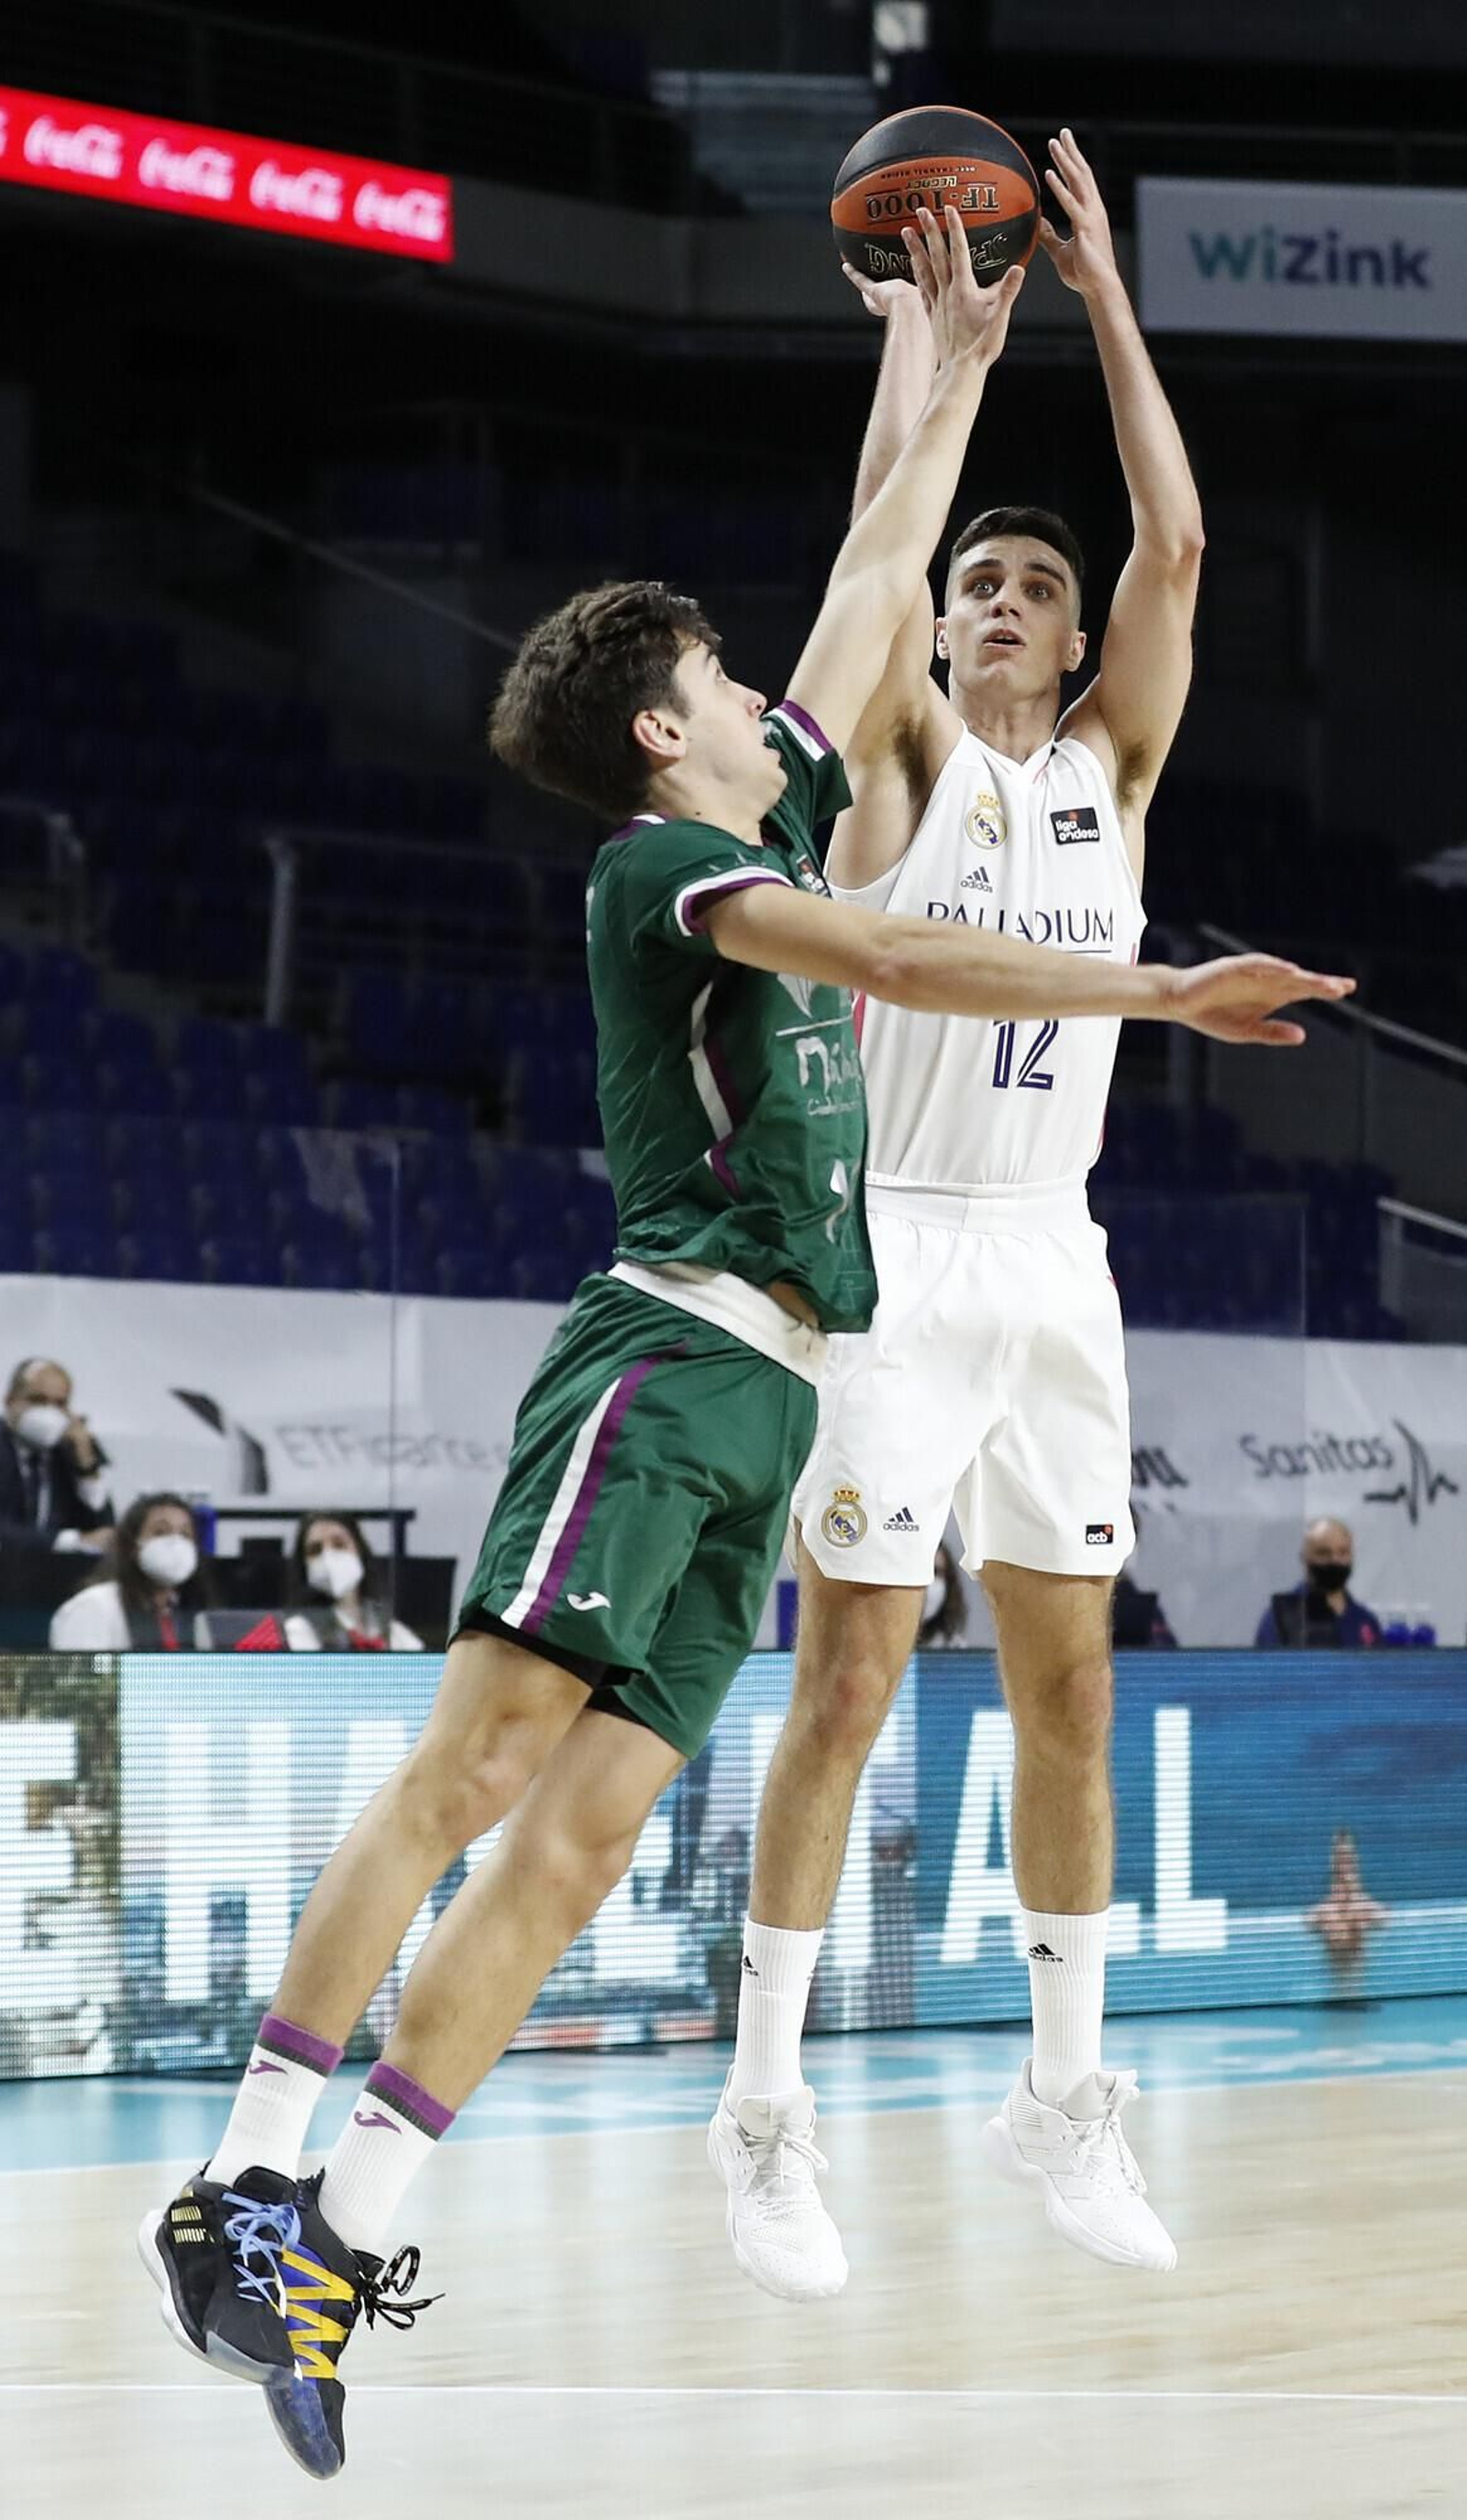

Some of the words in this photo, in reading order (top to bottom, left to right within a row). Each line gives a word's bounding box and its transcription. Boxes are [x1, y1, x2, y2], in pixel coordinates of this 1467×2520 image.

[866, 186, 999, 221] TF-1000
[1188, 226, 1430, 290] WiZink
[960, 878, 994, 894] adidas
[992, 1016, 1060, 1090] 12
[1240, 1431, 1393, 1479] Sanitas
[882, 1521, 920, 1532] adidas
[1086, 1531, 1109, 1543] acb
